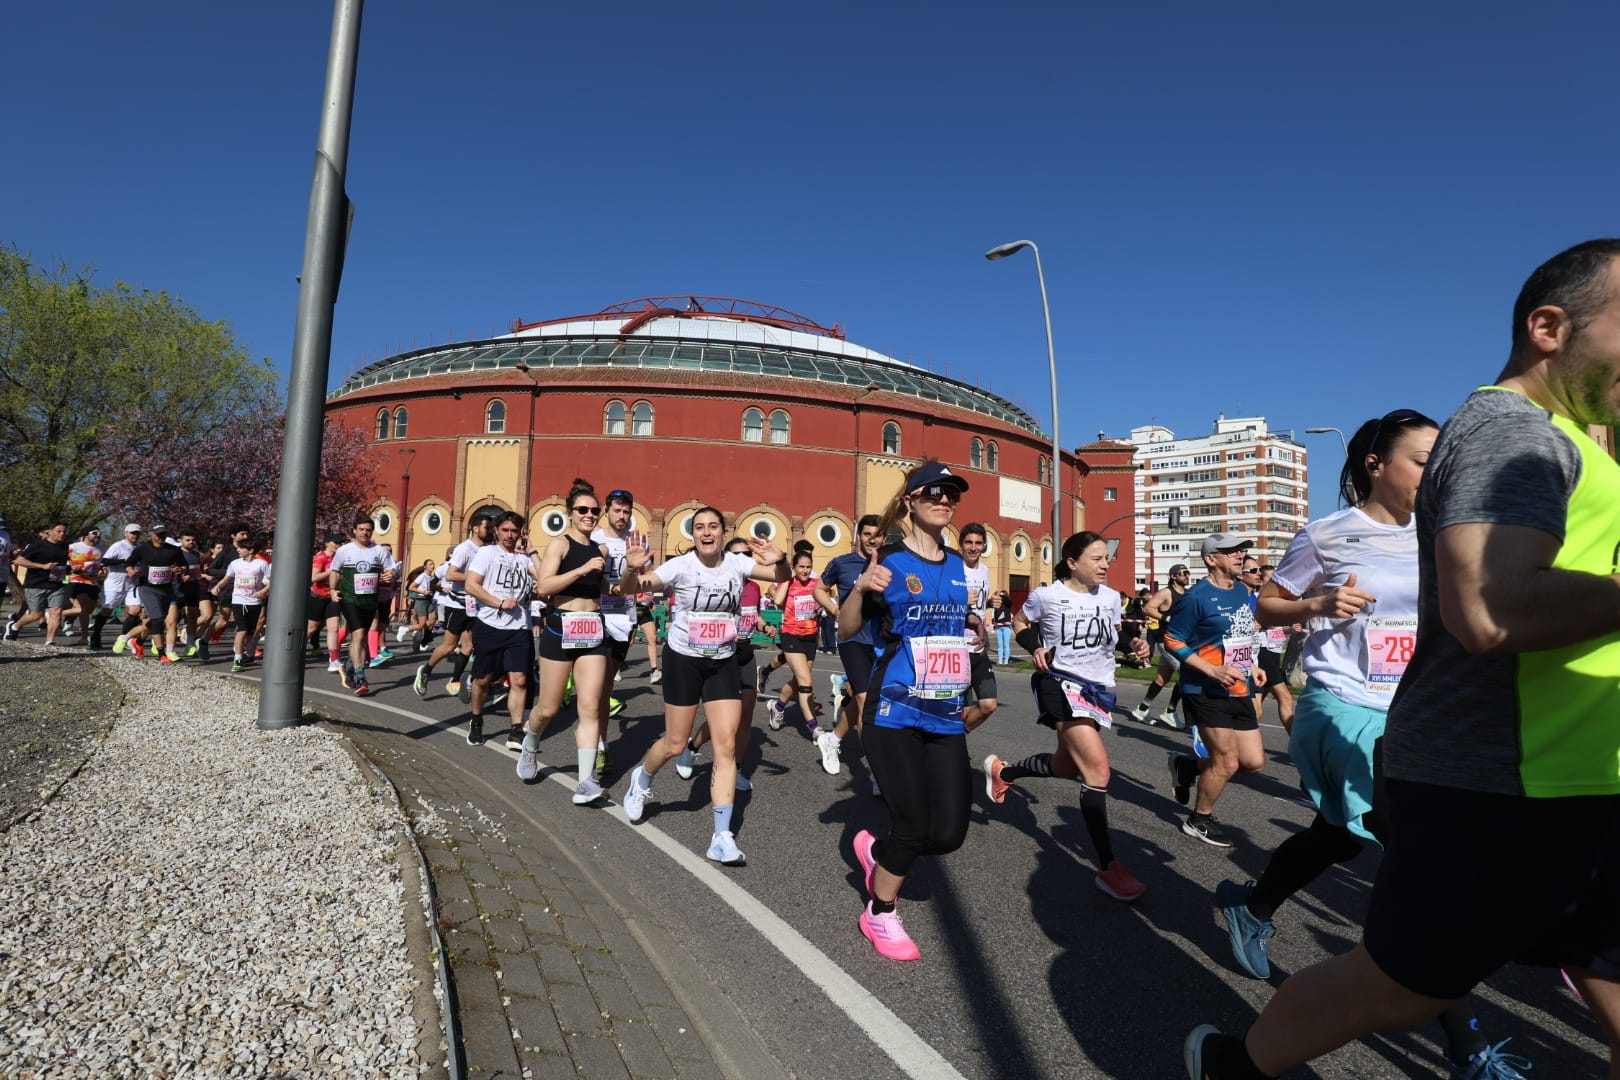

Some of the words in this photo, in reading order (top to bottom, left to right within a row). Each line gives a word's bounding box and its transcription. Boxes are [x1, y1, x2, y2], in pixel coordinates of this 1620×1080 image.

[570, 621, 597, 635] 2800
[700, 623, 726, 639] 2917
[1060, 606, 1113, 650] LEÓN
[928, 652, 961, 674] 2716
